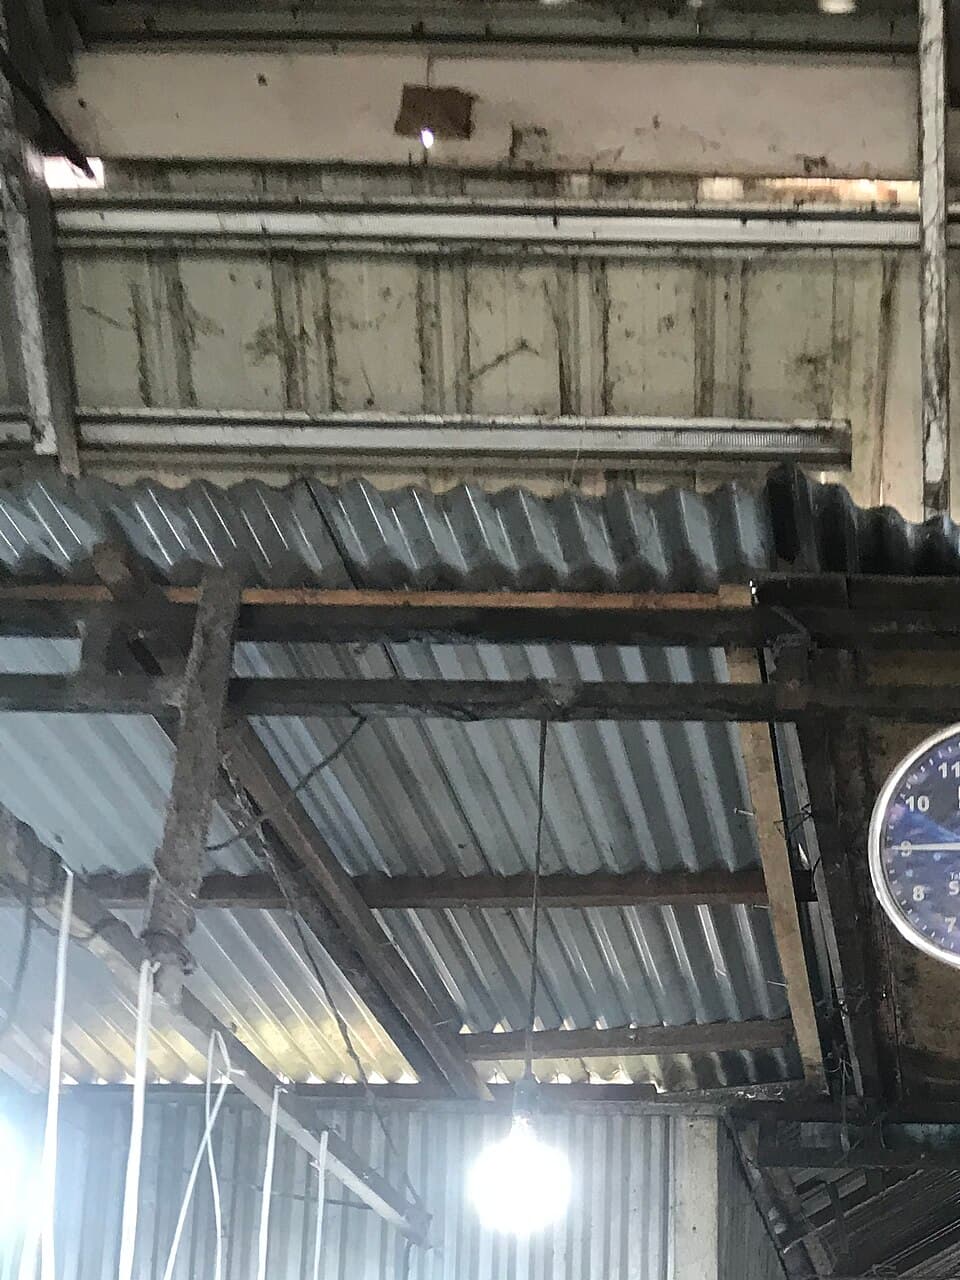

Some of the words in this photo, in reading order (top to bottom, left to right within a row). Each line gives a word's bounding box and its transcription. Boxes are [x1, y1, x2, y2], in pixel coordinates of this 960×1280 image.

[938, 761, 960, 778] 11
[905, 795, 930, 812] 10
[900, 840, 912, 857] 9
[912, 884, 925, 901] 8
[944, 916, 957, 933] 7
